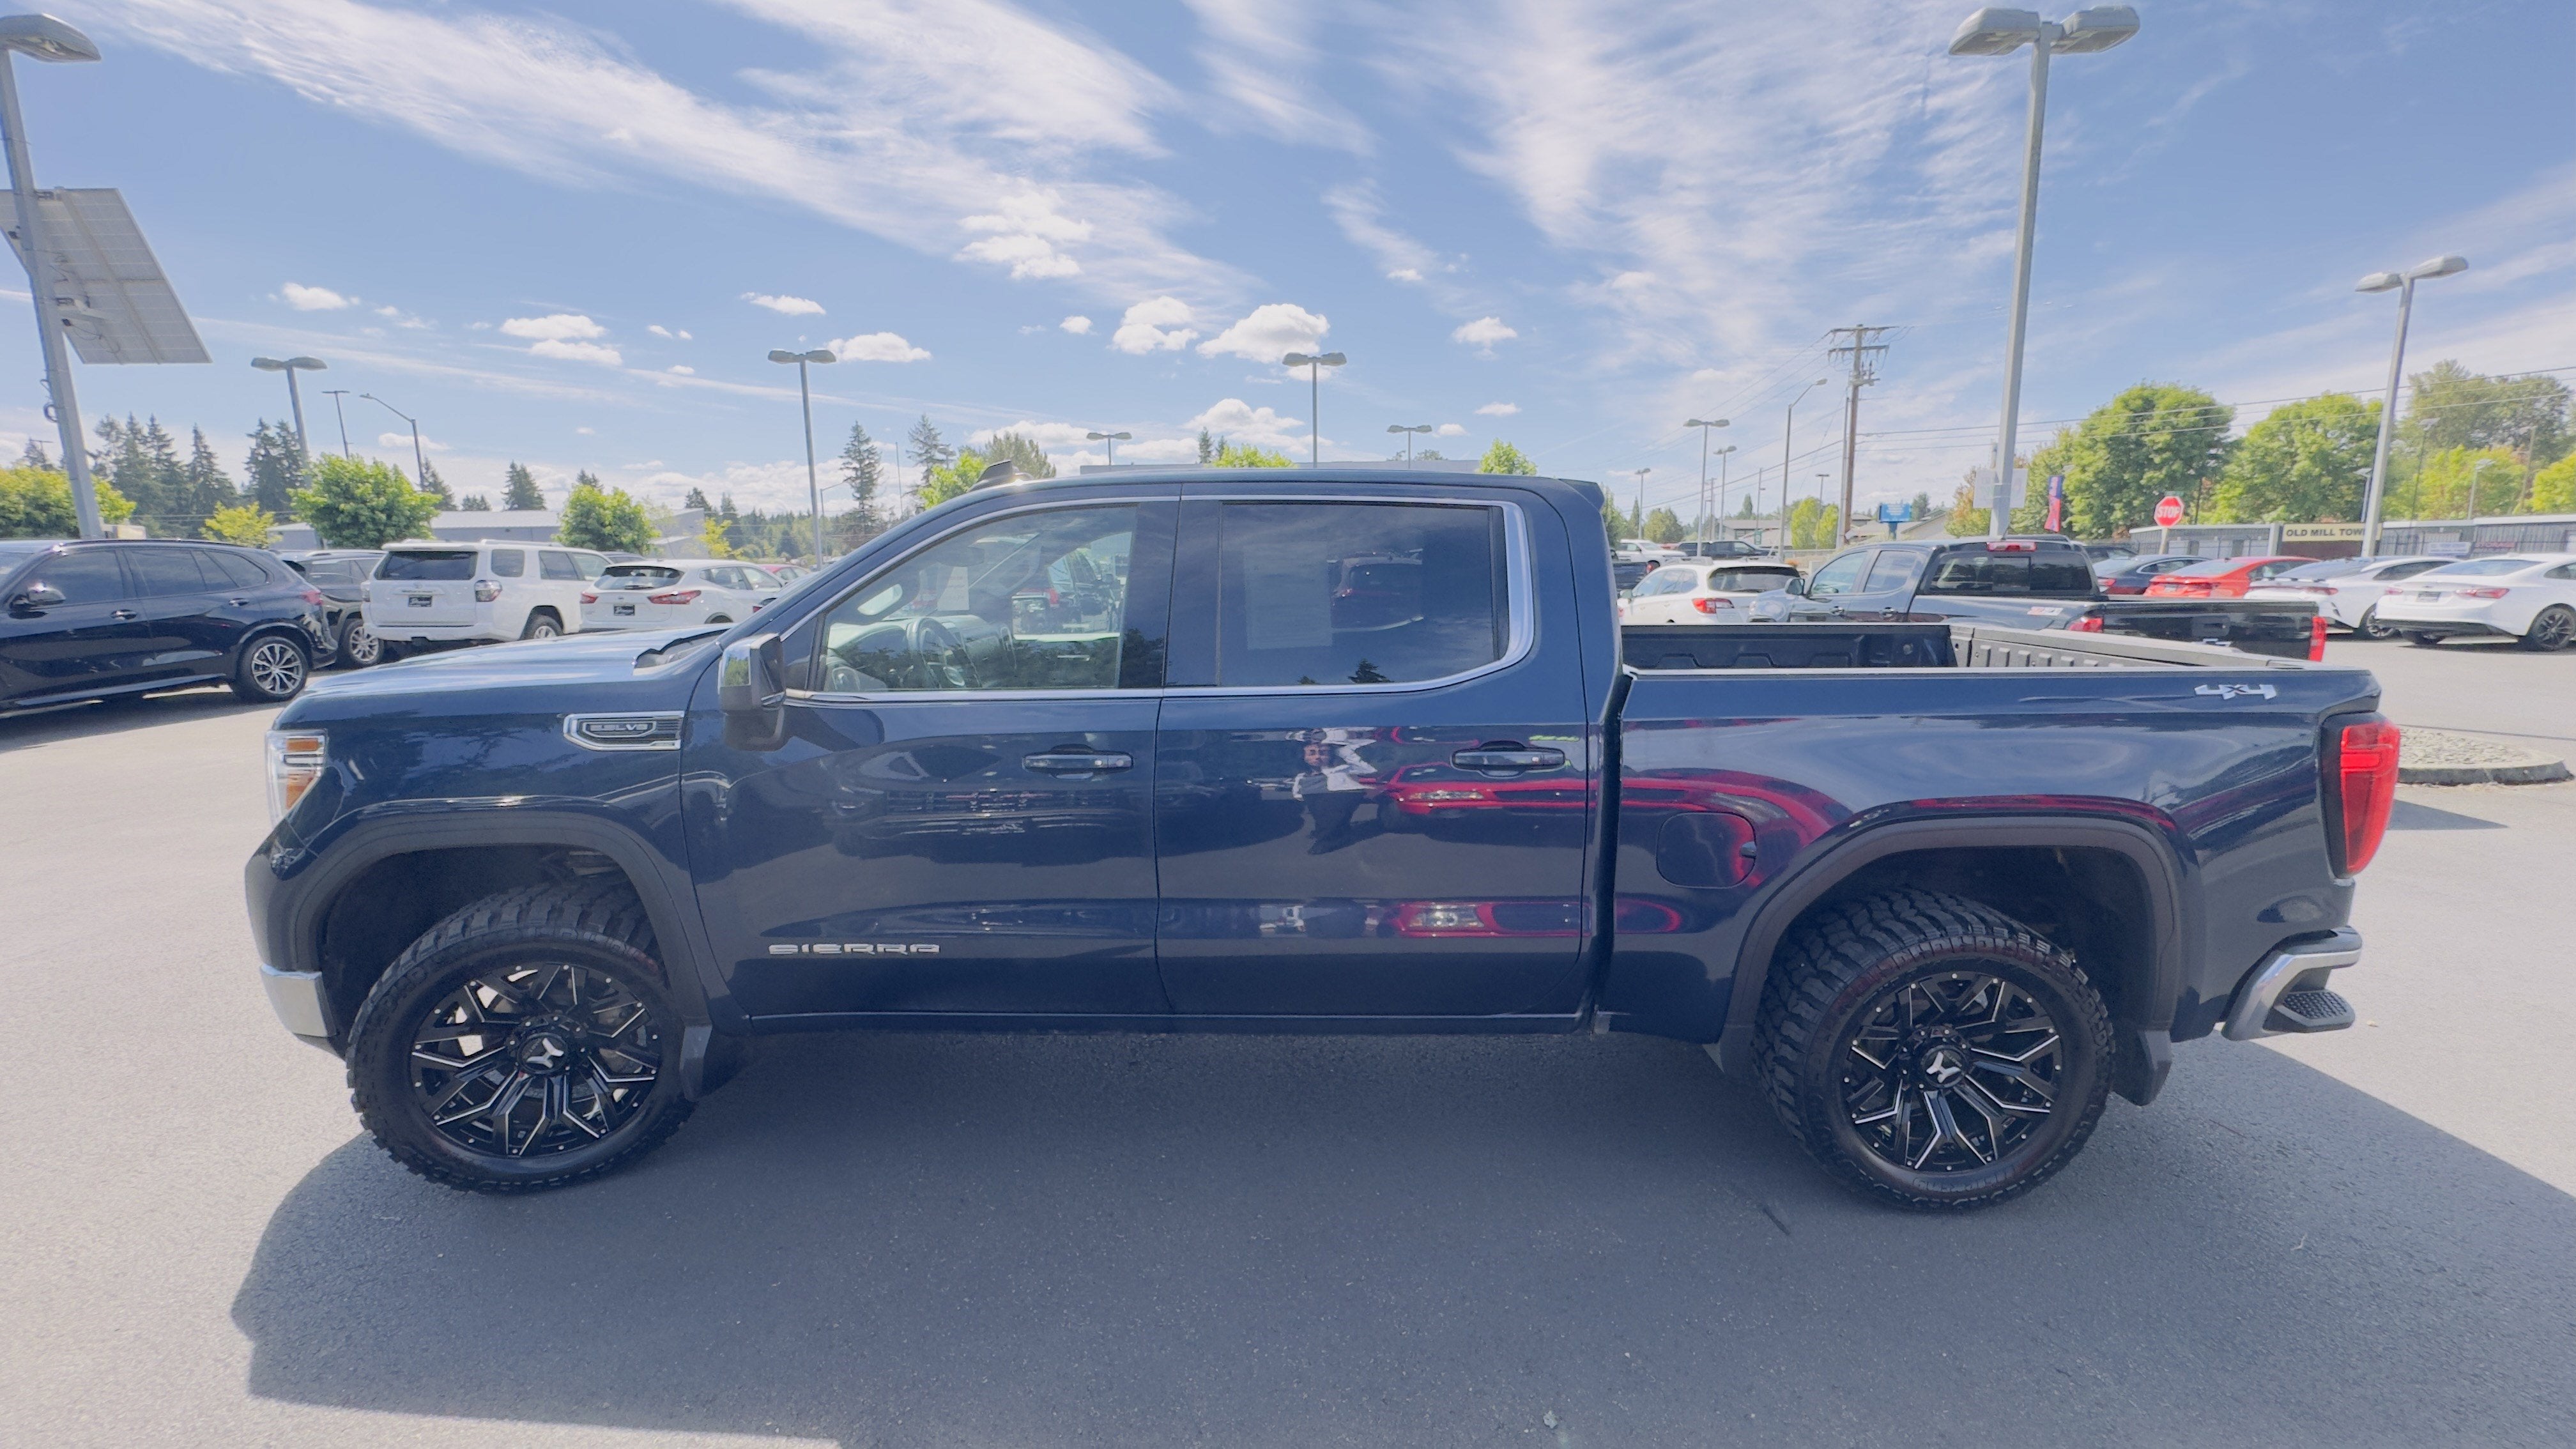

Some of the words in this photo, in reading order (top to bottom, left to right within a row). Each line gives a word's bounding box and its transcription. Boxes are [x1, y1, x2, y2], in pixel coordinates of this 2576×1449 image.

[2156, 506, 2181, 518] STOP
[2339, 528, 2365, 536] TOW
[769, 943, 940, 955] SIERRA
